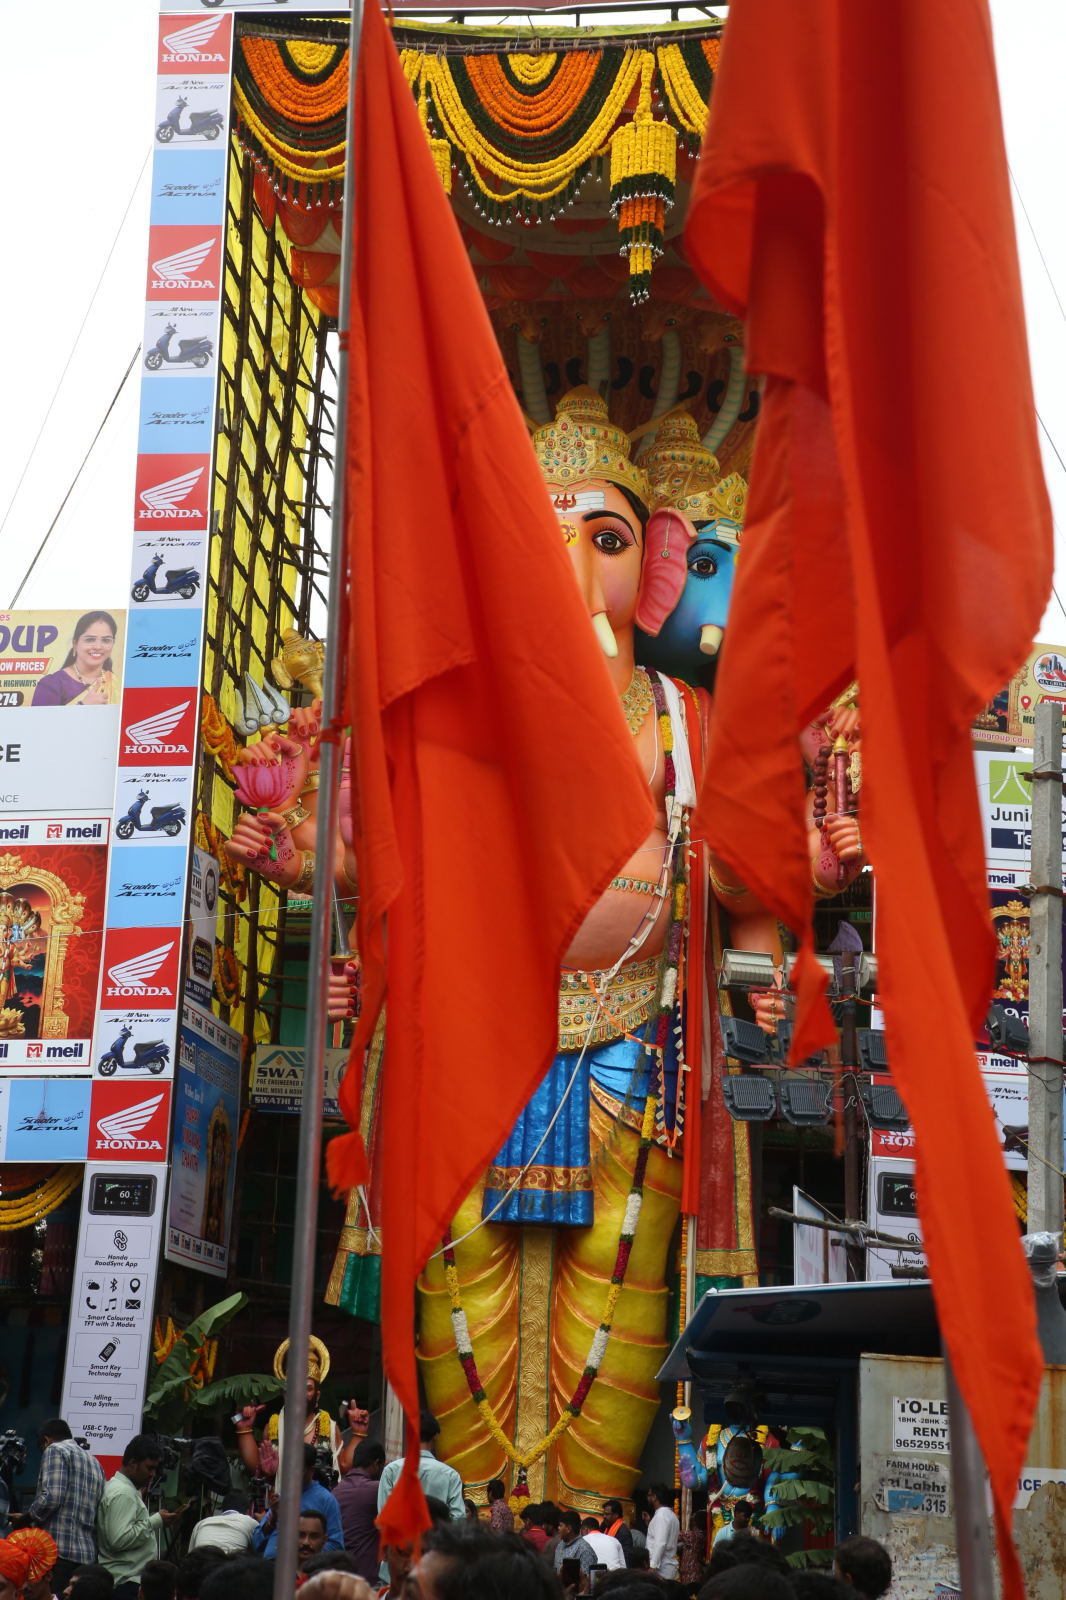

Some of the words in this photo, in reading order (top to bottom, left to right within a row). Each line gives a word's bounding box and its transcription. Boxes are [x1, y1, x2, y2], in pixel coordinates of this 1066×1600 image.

[162, 53, 225, 62] HONDA
[151, 280, 216, 289] HONDA
[139, 509, 204, 518] HONDA
[135, 644, 176, 652] Scooter
[15, 661, 45, 671] PRICES
[3, 679, 37, 687] HIGHWAYS
[0, 743, 21, 763] E
[124, 744, 190, 754] HONDA
[991, 807, 1032, 822] Juni
[66, 823, 102, 838] meil
[988, 873, 1016, 885] meil
[118, 882, 160, 890] Scooter
[105, 986, 173, 996] HONDA
[46, 1043, 84, 1058] meil
[990, 1057, 1019, 1068] meil
[254, 1096, 291, 1106] SWATHI
[20, 1116, 62, 1124] Scooter
[96, 1139, 163, 1149] HONDA
[879, 1134, 916, 1146] HO
[119, 1190, 131, 1199] 60
[94, 1260, 124, 1268] RoadSync
[125, 1261, 138, 1269] App
[902, 1257, 925, 1265] Honda
[88, 1370, 122, 1378] Technology
[93, 1394, 112, 1402] Idling
[103, 1425, 118, 1433] Type
[913, 1426, 949, 1438] RENT
[85, 1432, 114, 1440] Charging
[886, 1460, 911, 1470] FARM
